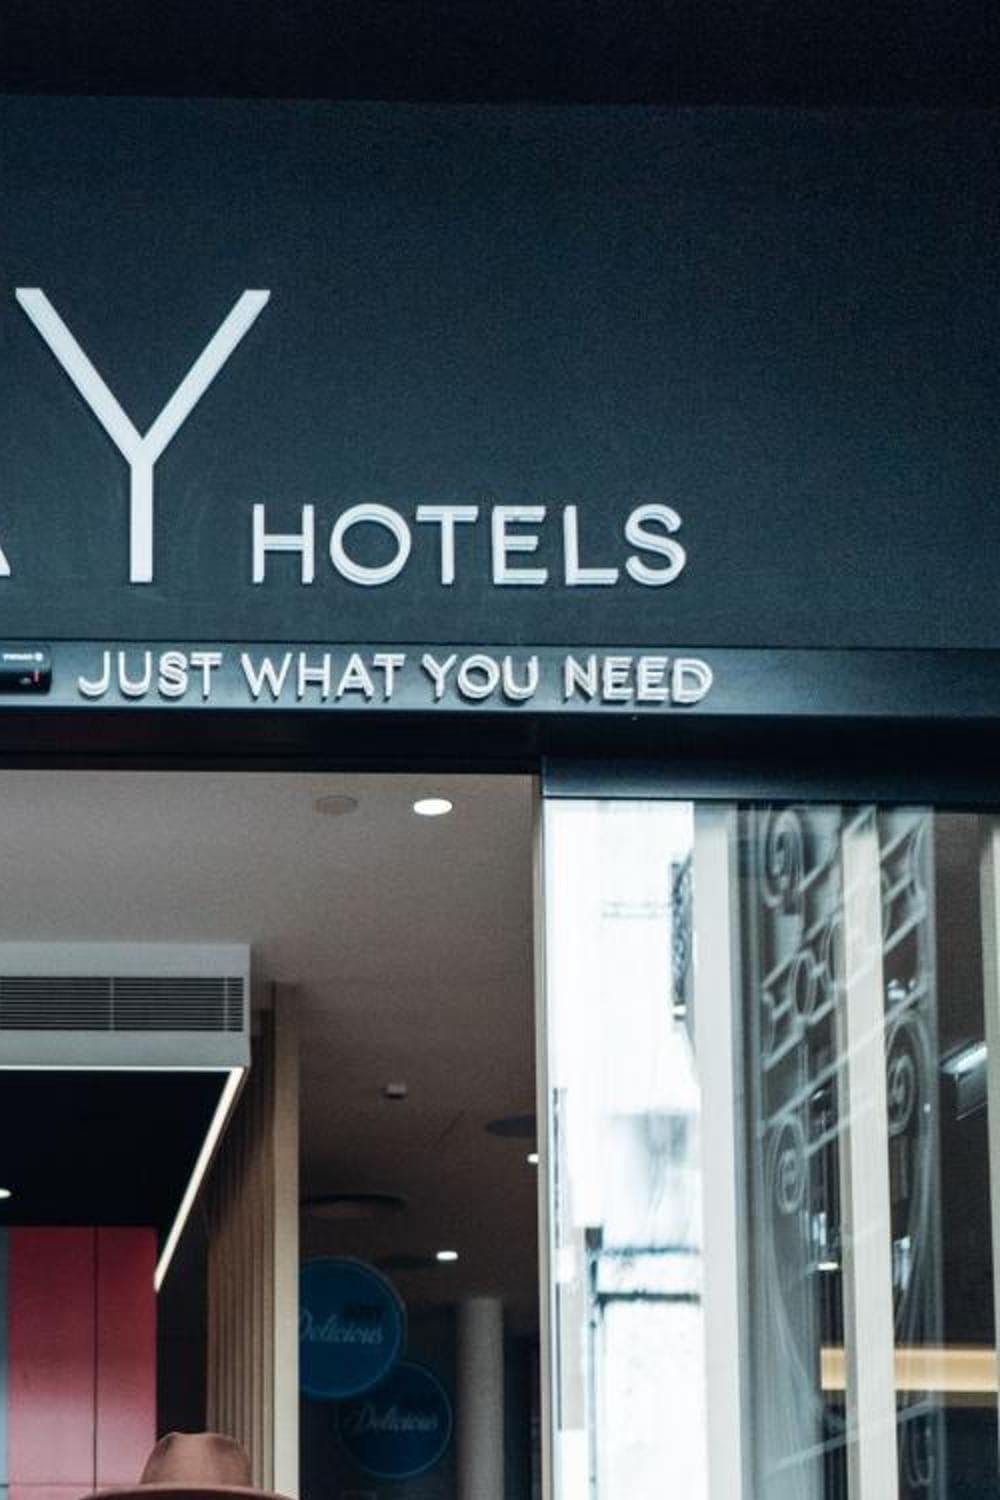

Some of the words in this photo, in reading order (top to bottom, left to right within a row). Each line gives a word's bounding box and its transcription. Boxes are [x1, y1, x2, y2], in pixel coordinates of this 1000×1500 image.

[250, 502, 688, 586] HOTELS
[77, 650, 223, 700] JUST
[241, 651, 406, 699] WHAT
[422, 653, 540, 701] YOU
[564, 654, 714, 704] NEED
